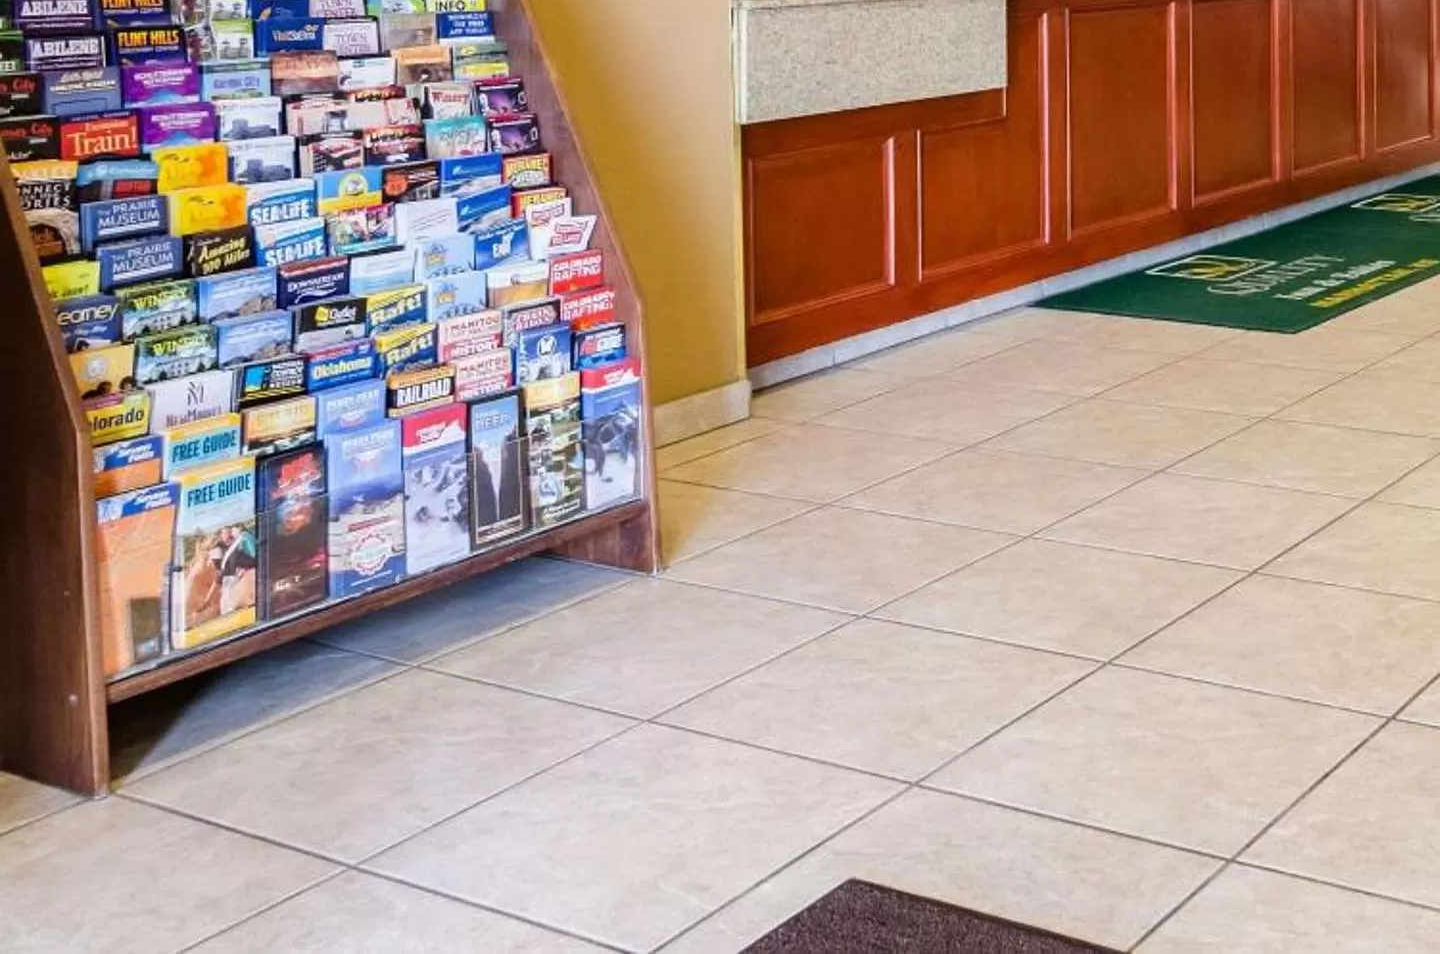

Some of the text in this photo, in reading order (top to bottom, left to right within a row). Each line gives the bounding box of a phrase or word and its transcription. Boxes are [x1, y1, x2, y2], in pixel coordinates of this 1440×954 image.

[20, 0, 88, 16] ABILENE
[435, 0, 465, 11] INFO
[32, 39, 99, 58] ABILENE
[118, 30, 179, 47] FLINT HILLS
[67, 126, 138, 156] Train!
[16, 182, 71, 195] NNECT
[22, 195, 71, 209] ORIES
[283, 200, 310, 220] LIFE
[97, 210, 160, 229] MUSEUM
[300, 238, 326, 260] LIFE
[112, 254, 174, 274] MUSEUM
[553, 255, 601, 271] COLORADO
[56, 303, 119, 326] earney
[314, 357, 374, 379] Oklahoma
[397, 377, 451, 405] RAILROAD
[91, 408, 145, 431] lorado
[172, 441, 200, 463] FREE
[203, 430, 237, 453] GUIDE
[187, 484, 215, 507] FREE
[218, 474, 251, 496] GUIDE
